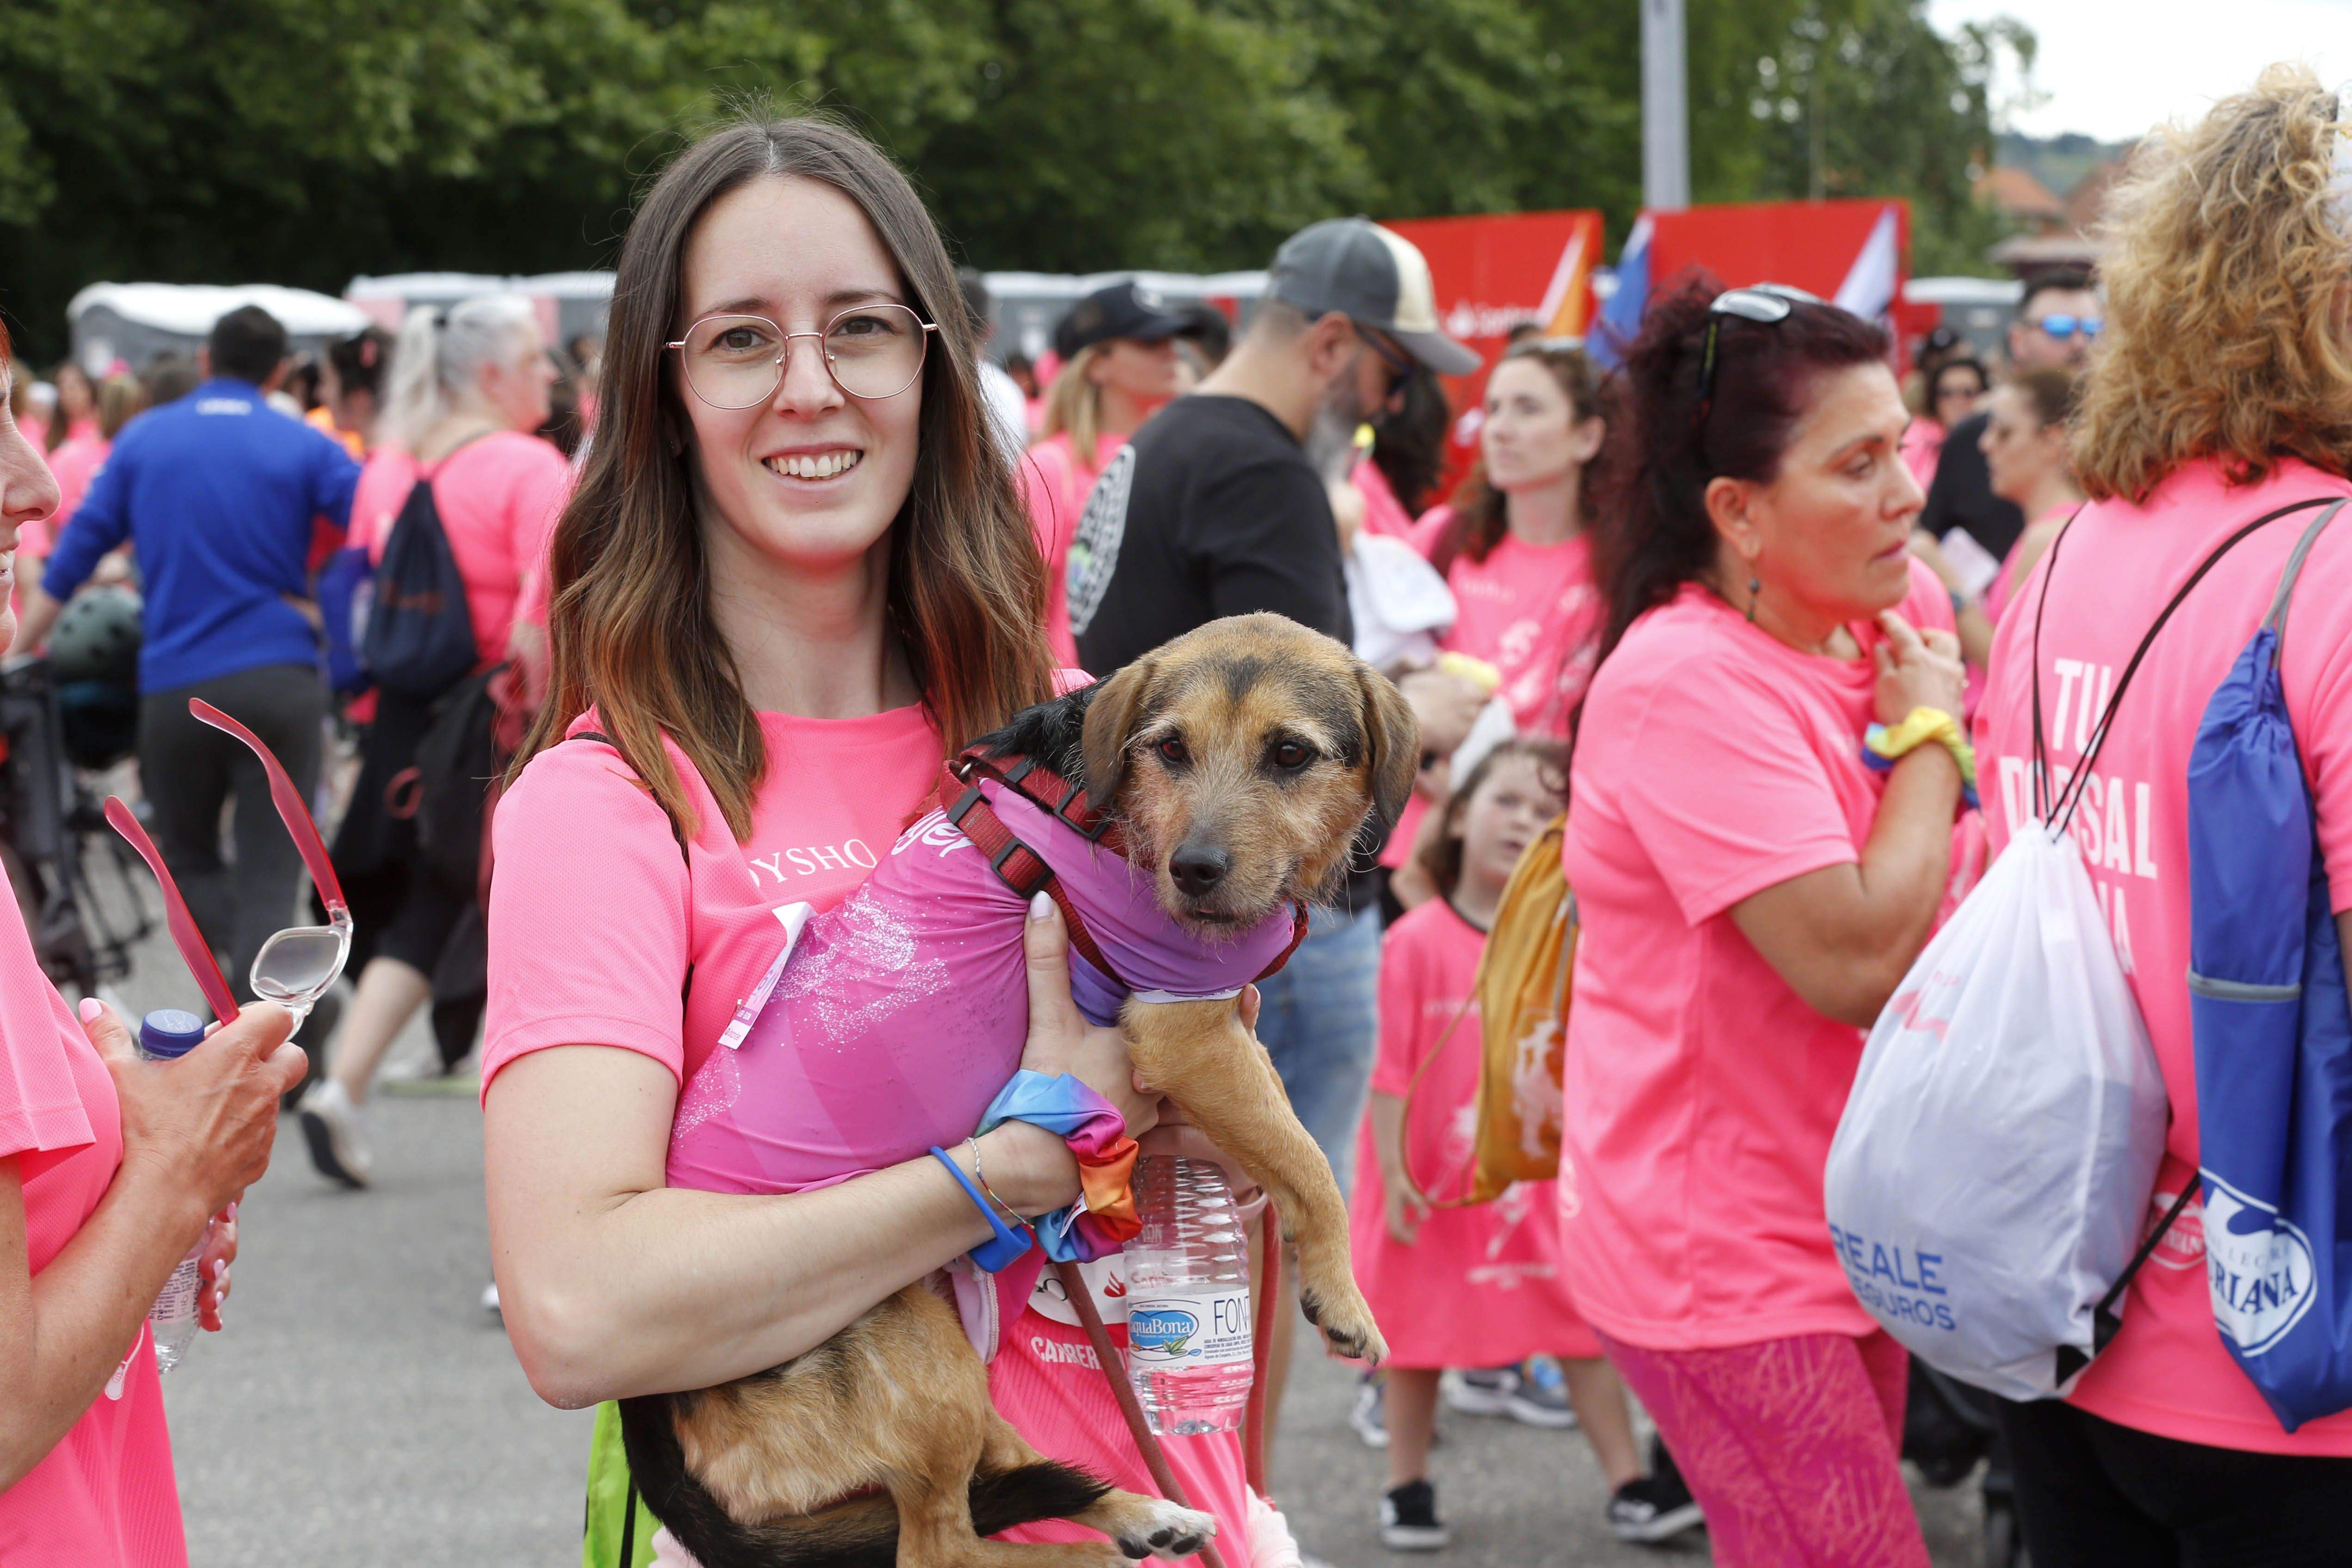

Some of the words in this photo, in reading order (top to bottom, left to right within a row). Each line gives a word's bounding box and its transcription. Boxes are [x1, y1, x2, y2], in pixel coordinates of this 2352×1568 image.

[2052, 658, 2112, 758] TU
[1999, 756, 2158, 879] DORSAL
[1031, 1336, 1103, 1370] CARRER
